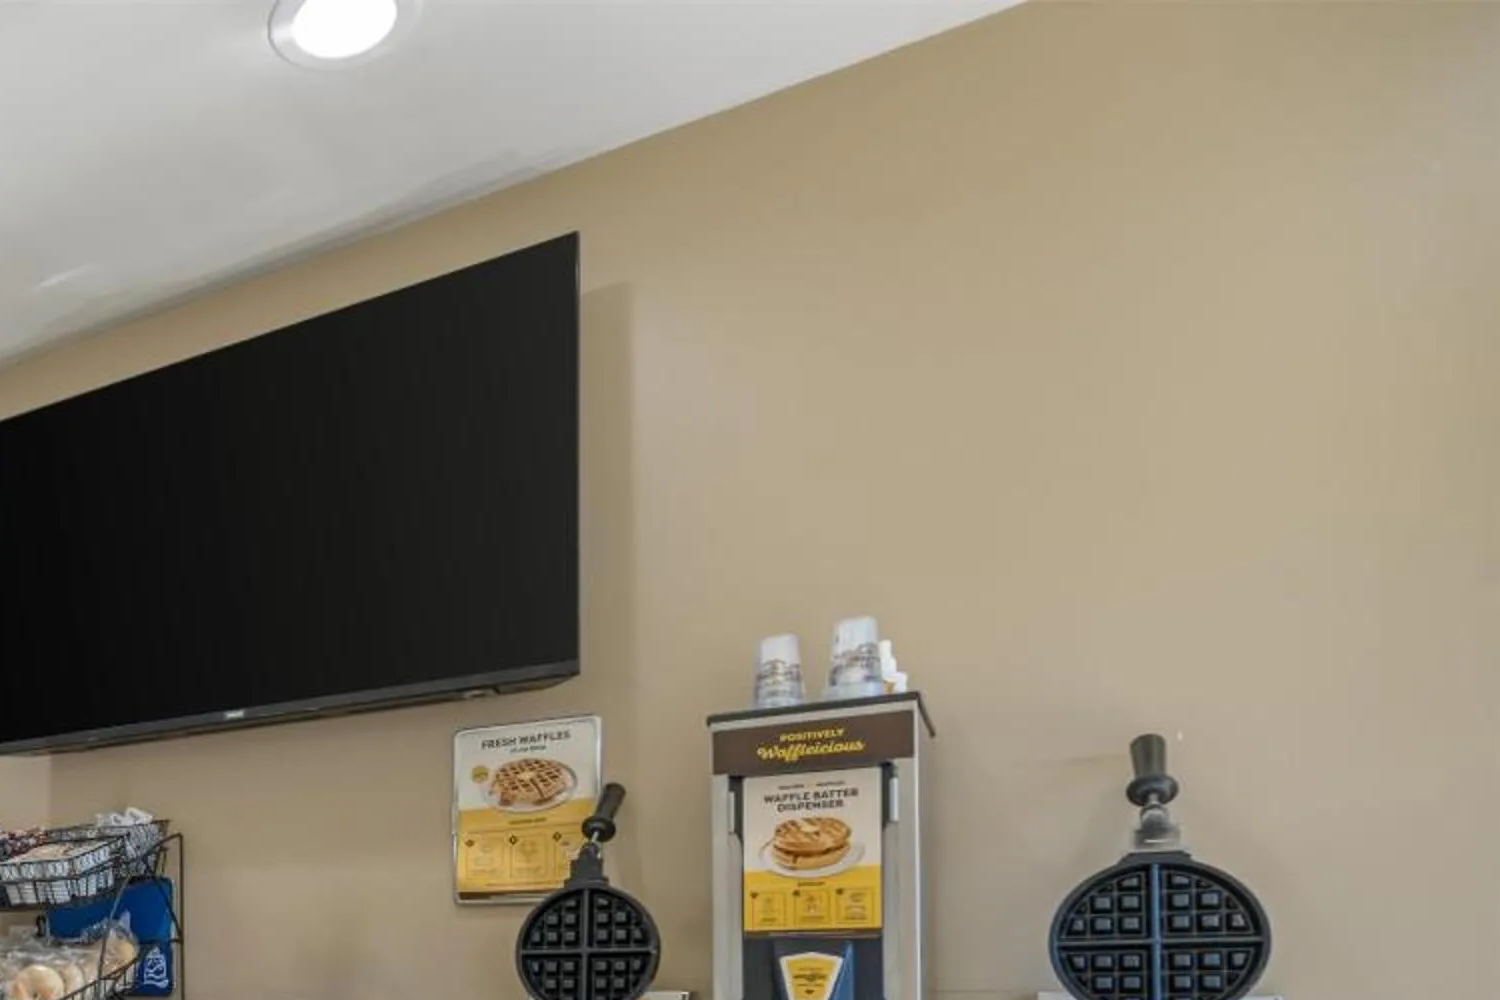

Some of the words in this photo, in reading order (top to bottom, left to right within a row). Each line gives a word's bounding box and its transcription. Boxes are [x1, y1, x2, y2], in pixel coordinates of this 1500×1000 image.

[481, 737, 517, 750] FRESH
[519, 730, 572, 745] WAFFLES
[779, 727, 845, 742] POSITIVELY
[763, 791, 810, 805] WAFFLE
[813, 788, 859, 800] BATTER
